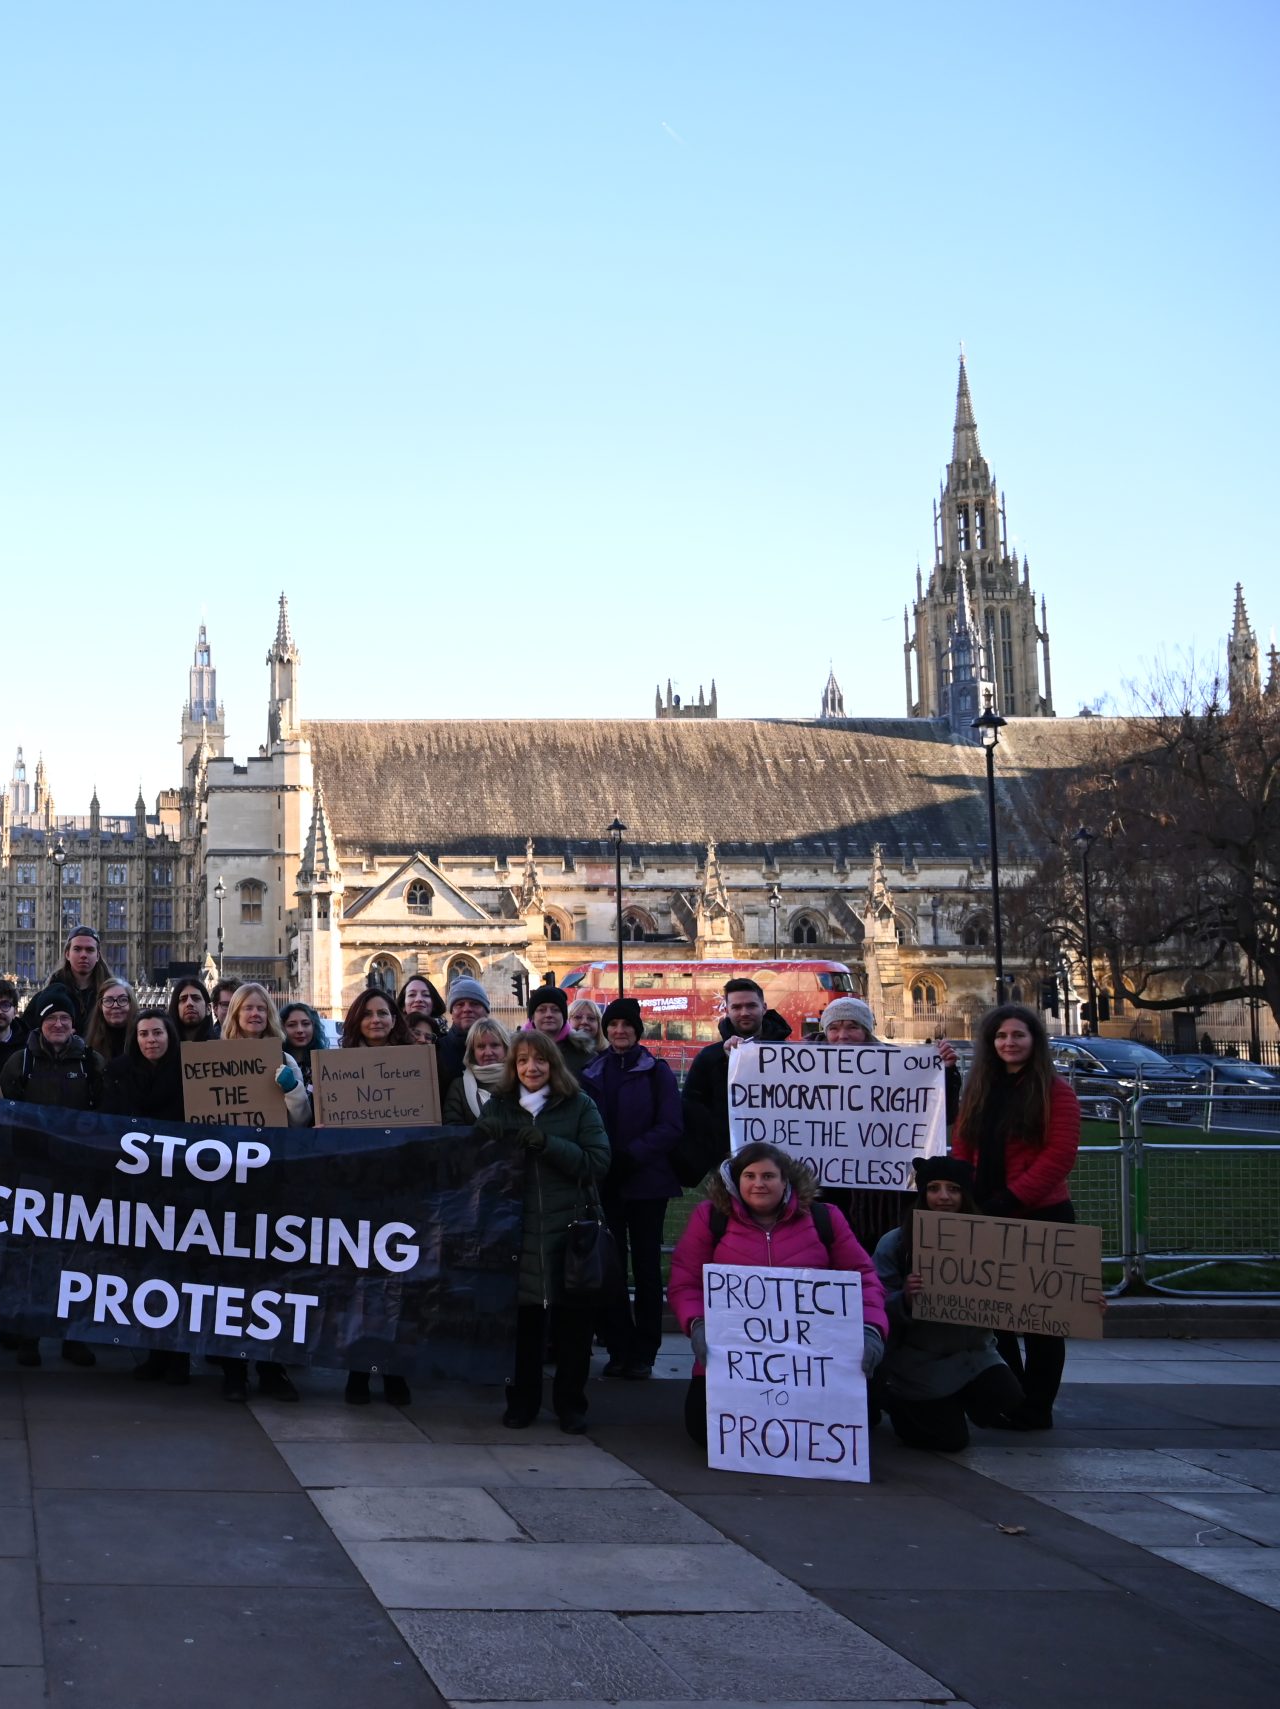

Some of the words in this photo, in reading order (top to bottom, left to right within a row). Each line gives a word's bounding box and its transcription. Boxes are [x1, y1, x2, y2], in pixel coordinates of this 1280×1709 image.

[637, 997, 688, 1007] HRISTMASES
[184, 1058, 267, 1079] DEFENDING
[321, 1065, 365, 1081] Animal
[374, 1062, 421, 1079] Torture
[759, 1046, 901, 1076] PROTECT
[904, 1055, 943, 1071] OUR
[209, 1086, 249, 1106] THE
[327, 1092, 338, 1103] is
[356, 1085, 396, 1103] NOT
[731, 1083, 864, 1111] DEMOCRATIC
[871, 1085, 935, 1113] RIGHT
[242, 1111, 266, 1127] TO
[734, 1117, 767, 1142] TO
[770, 1119, 802, 1146] BE
[805, 1120, 848, 1147] THE
[858, 1122, 927, 1149] VOICE
[115, 1131, 271, 1184] STOP
[919, 1217, 985, 1255] LET
[995, 1222, 1076, 1266] THE
[708, 1271, 857, 1316] PROTECT
[919, 1255, 1018, 1291] HOUSE
[1029, 1266, 1102, 1304] VOTE
[56, 1270, 319, 1344] PROTEST
[915, 1292, 932, 1306] ON
[937, 1295, 976, 1309] PUBLIC
[978, 1299, 1013, 1315] ORDER
[1021, 1303, 1053, 1321] ACT
[920, 1306, 1000, 1327] DRACONIAN
[1008, 1315, 1070, 1336] AMENDS
[744, 1317, 811, 1344] OUR
[728, 1351, 833, 1387] RIGHT
[760, 1389, 789, 1406] TO
[720, 1413, 862, 1466] PROTEST
